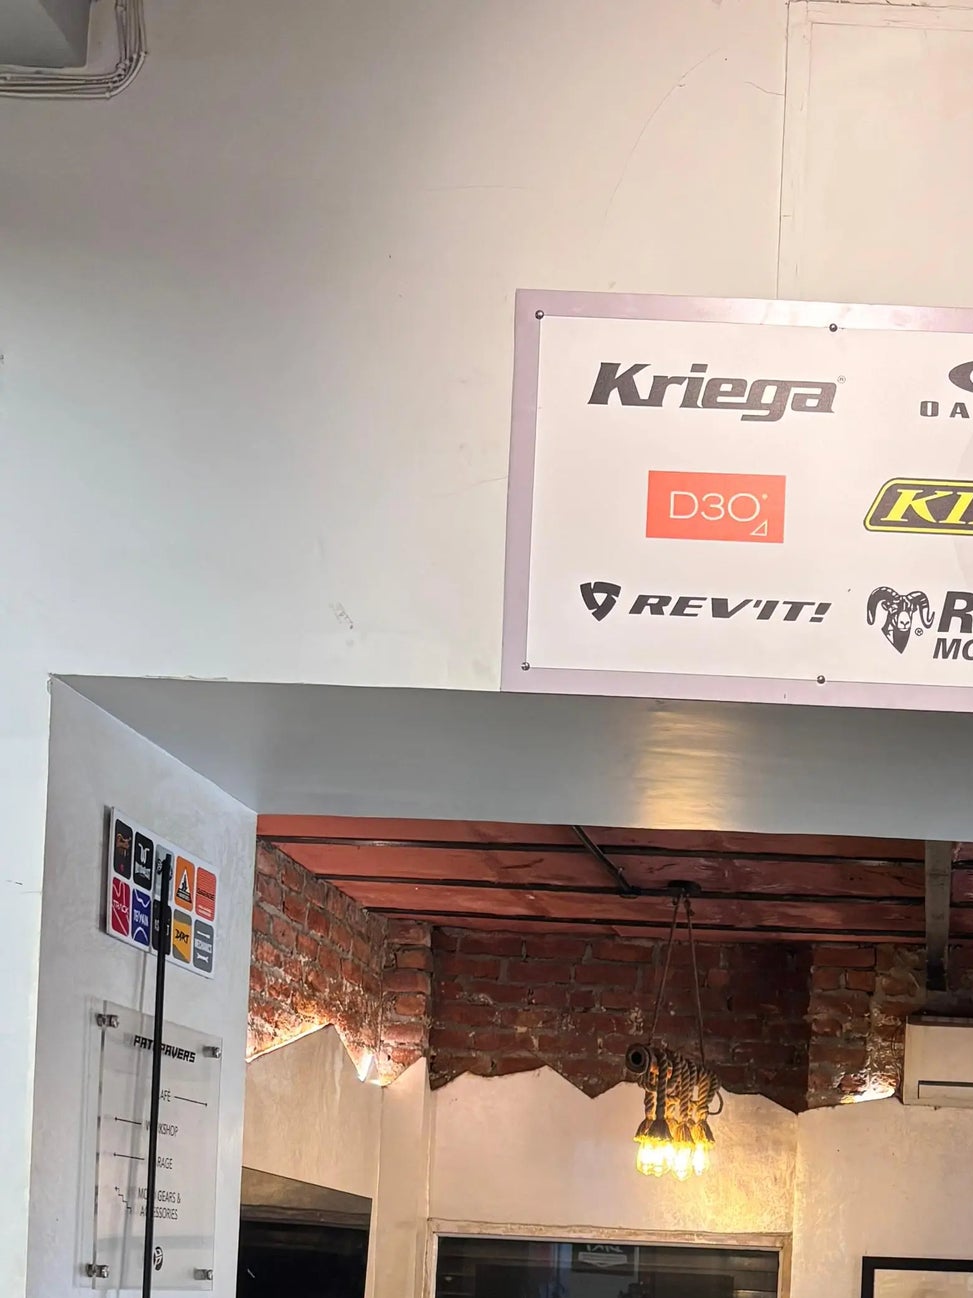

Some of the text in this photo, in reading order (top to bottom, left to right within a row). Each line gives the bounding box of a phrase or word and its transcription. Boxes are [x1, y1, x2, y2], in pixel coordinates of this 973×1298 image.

[588, 362, 835, 422] Kriega
[628, 593, 832, 624] REV'IT!
[133, 1035, 196, 1063] PATPAVERS
[145, 1119, 179, 1137] WKSHOP
[157, 1189, 176, 1203] GEARS
[139, 1205, 179, 1220] AESSORIES
